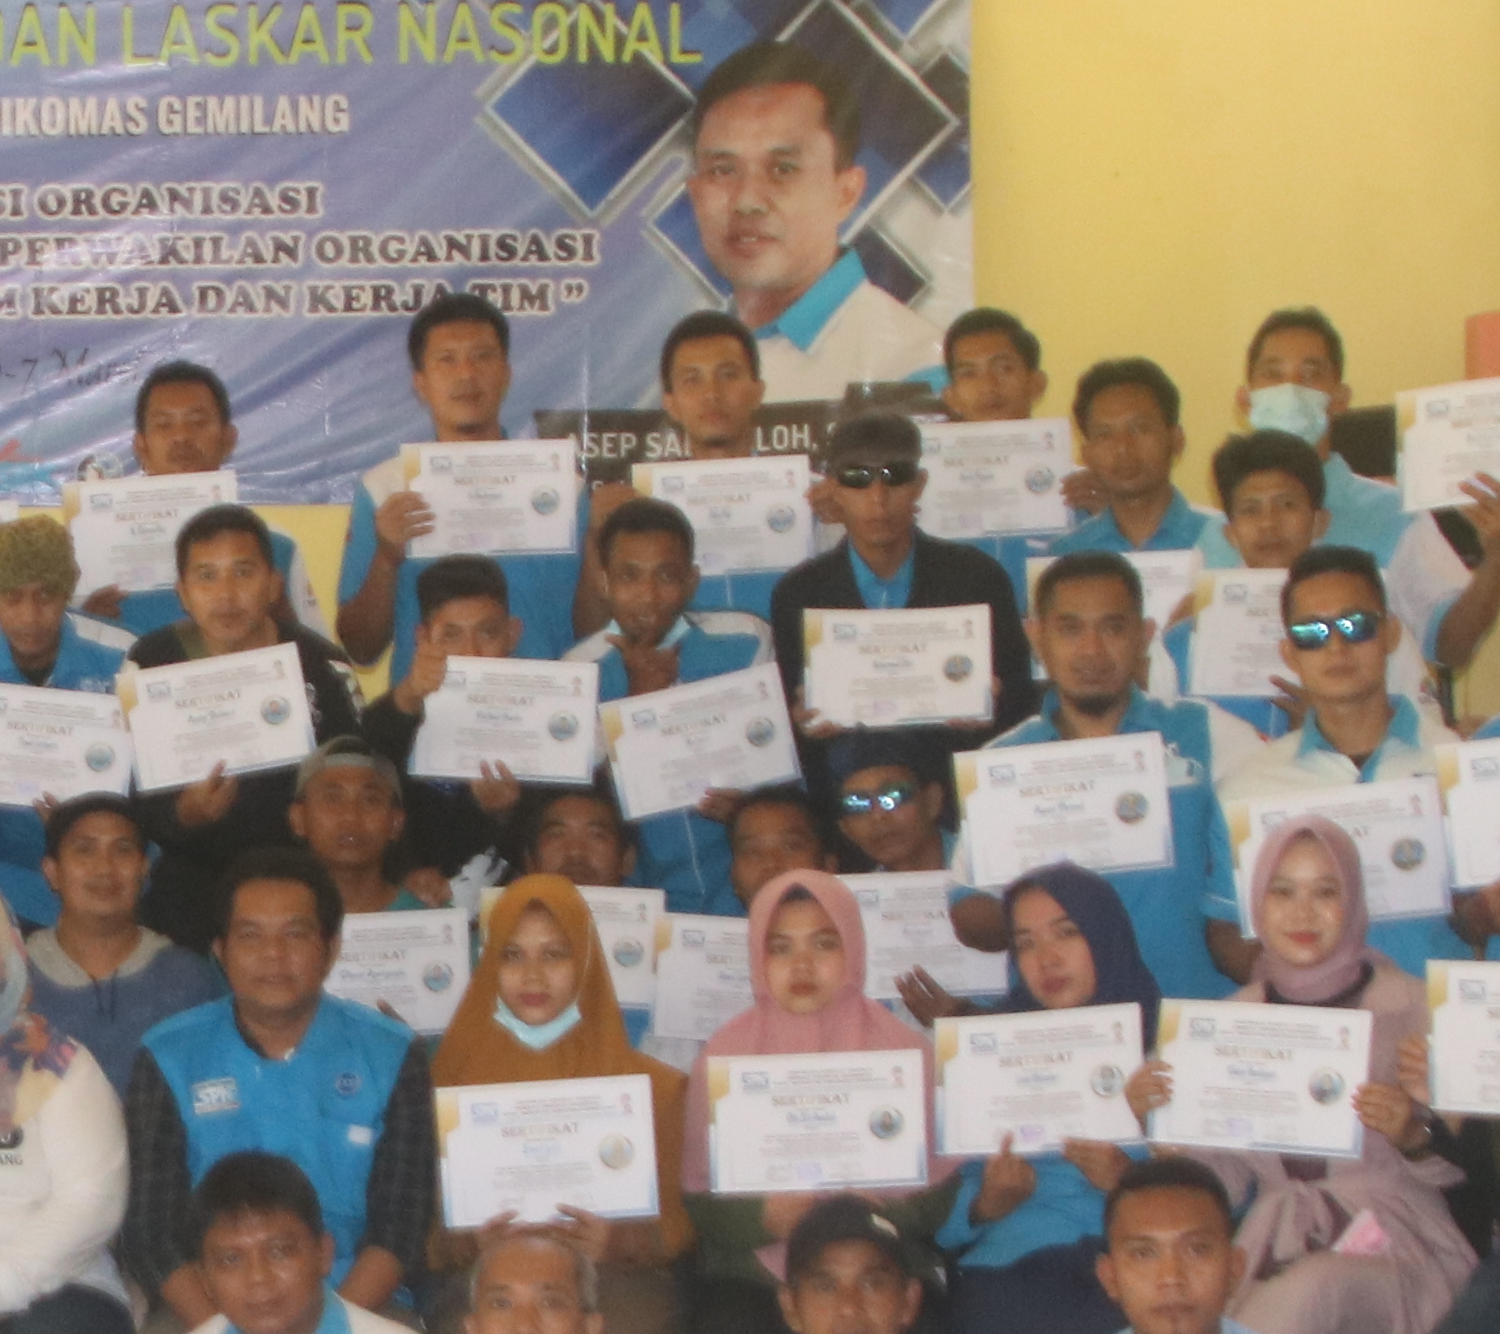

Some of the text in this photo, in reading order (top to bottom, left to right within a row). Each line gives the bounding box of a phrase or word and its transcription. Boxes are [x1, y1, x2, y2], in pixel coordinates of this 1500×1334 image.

[122, 1, 374, 67] LASKAR
[400, 0, 704, 65] NASONAL
[156, 93, 350, 136] GEMILANG
[36, 183, 322, 218] ORGANISASI
[314, 231, 599, 267] ORGANISASI
[30, 282, 191, 317] KERJA
[196, 282, 295, 316] DAN
[566, 431, 638, 458] ASEP
